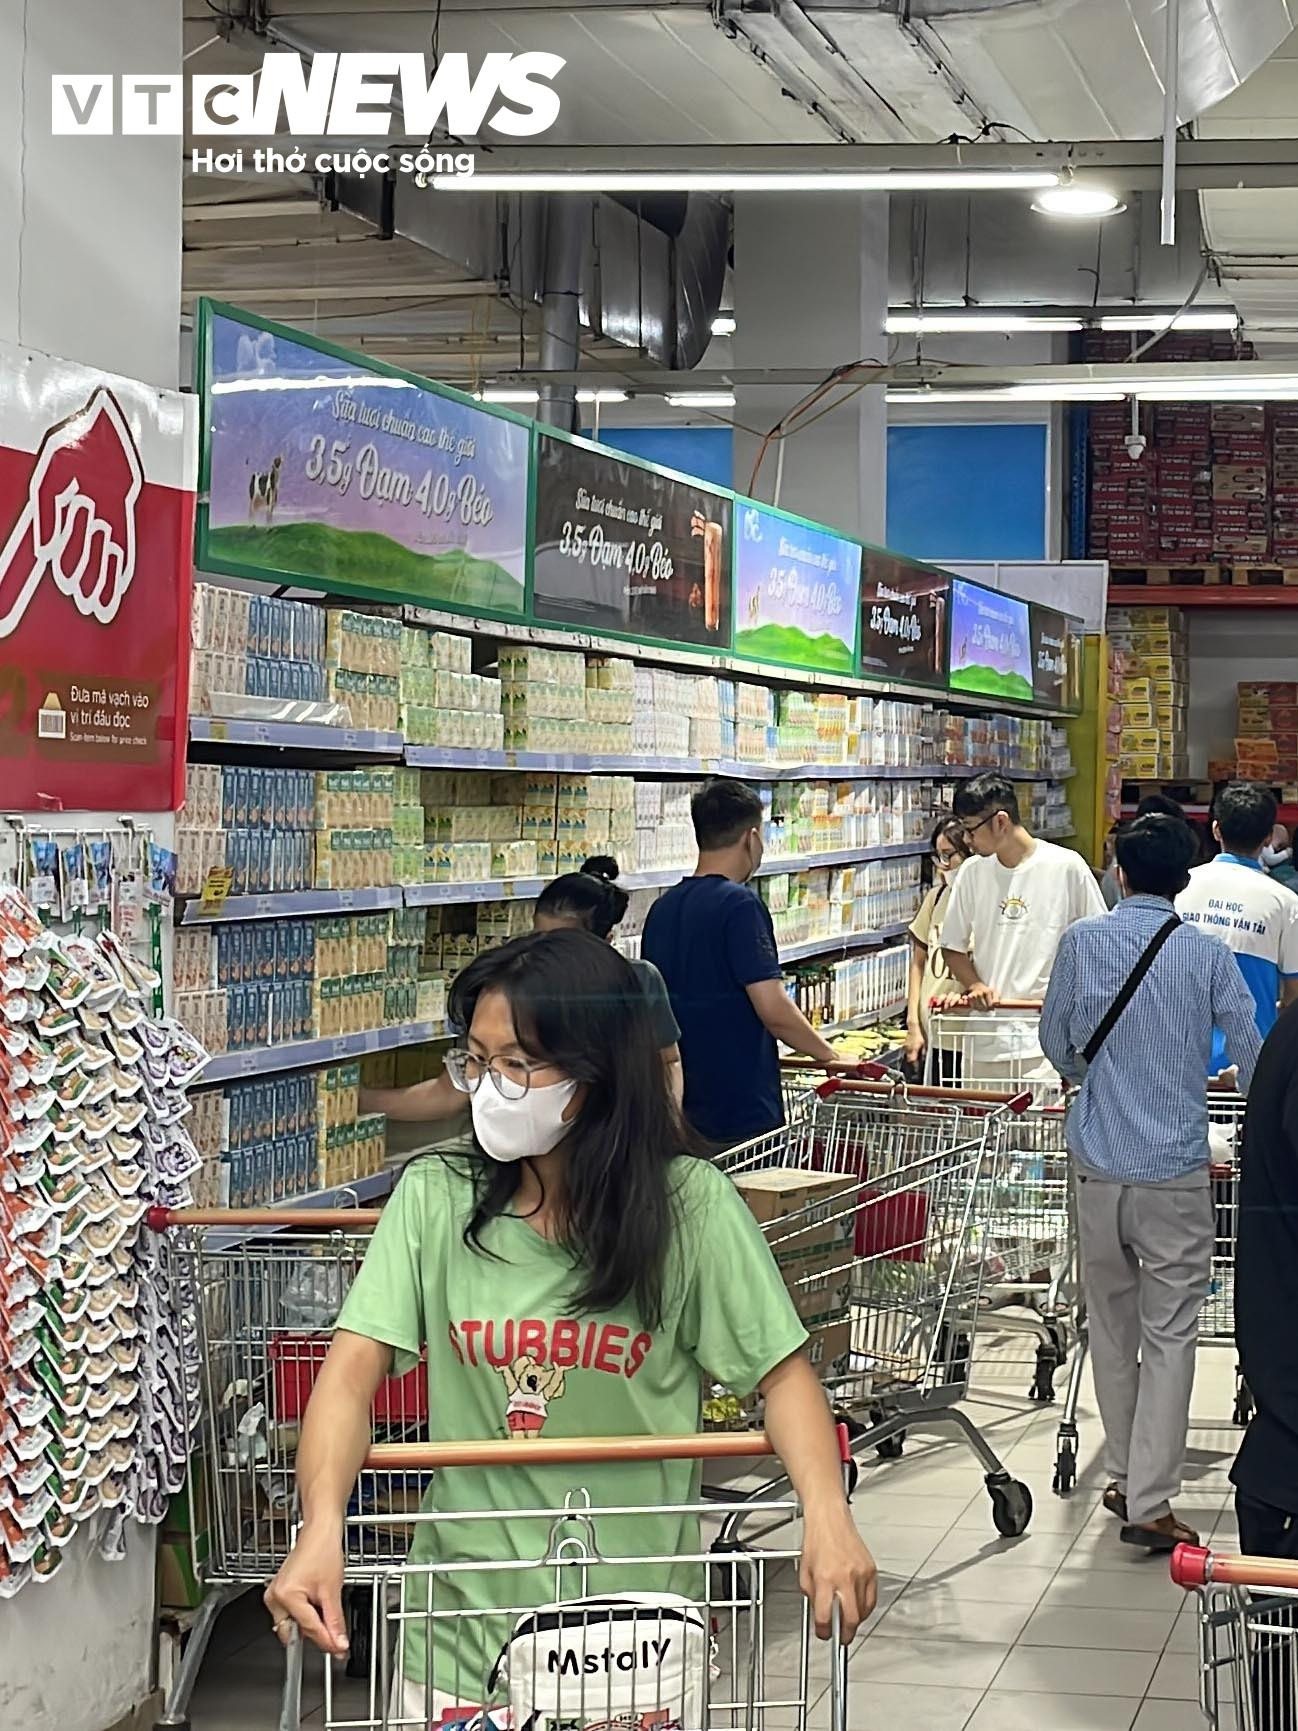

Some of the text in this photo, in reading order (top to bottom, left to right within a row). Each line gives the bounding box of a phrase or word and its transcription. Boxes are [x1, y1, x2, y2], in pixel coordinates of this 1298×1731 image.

[71, 685, 90, 703] Đưa
[109, 690, 130, 707] vạch
[1203, 914, 1231, 926] THÔNG
